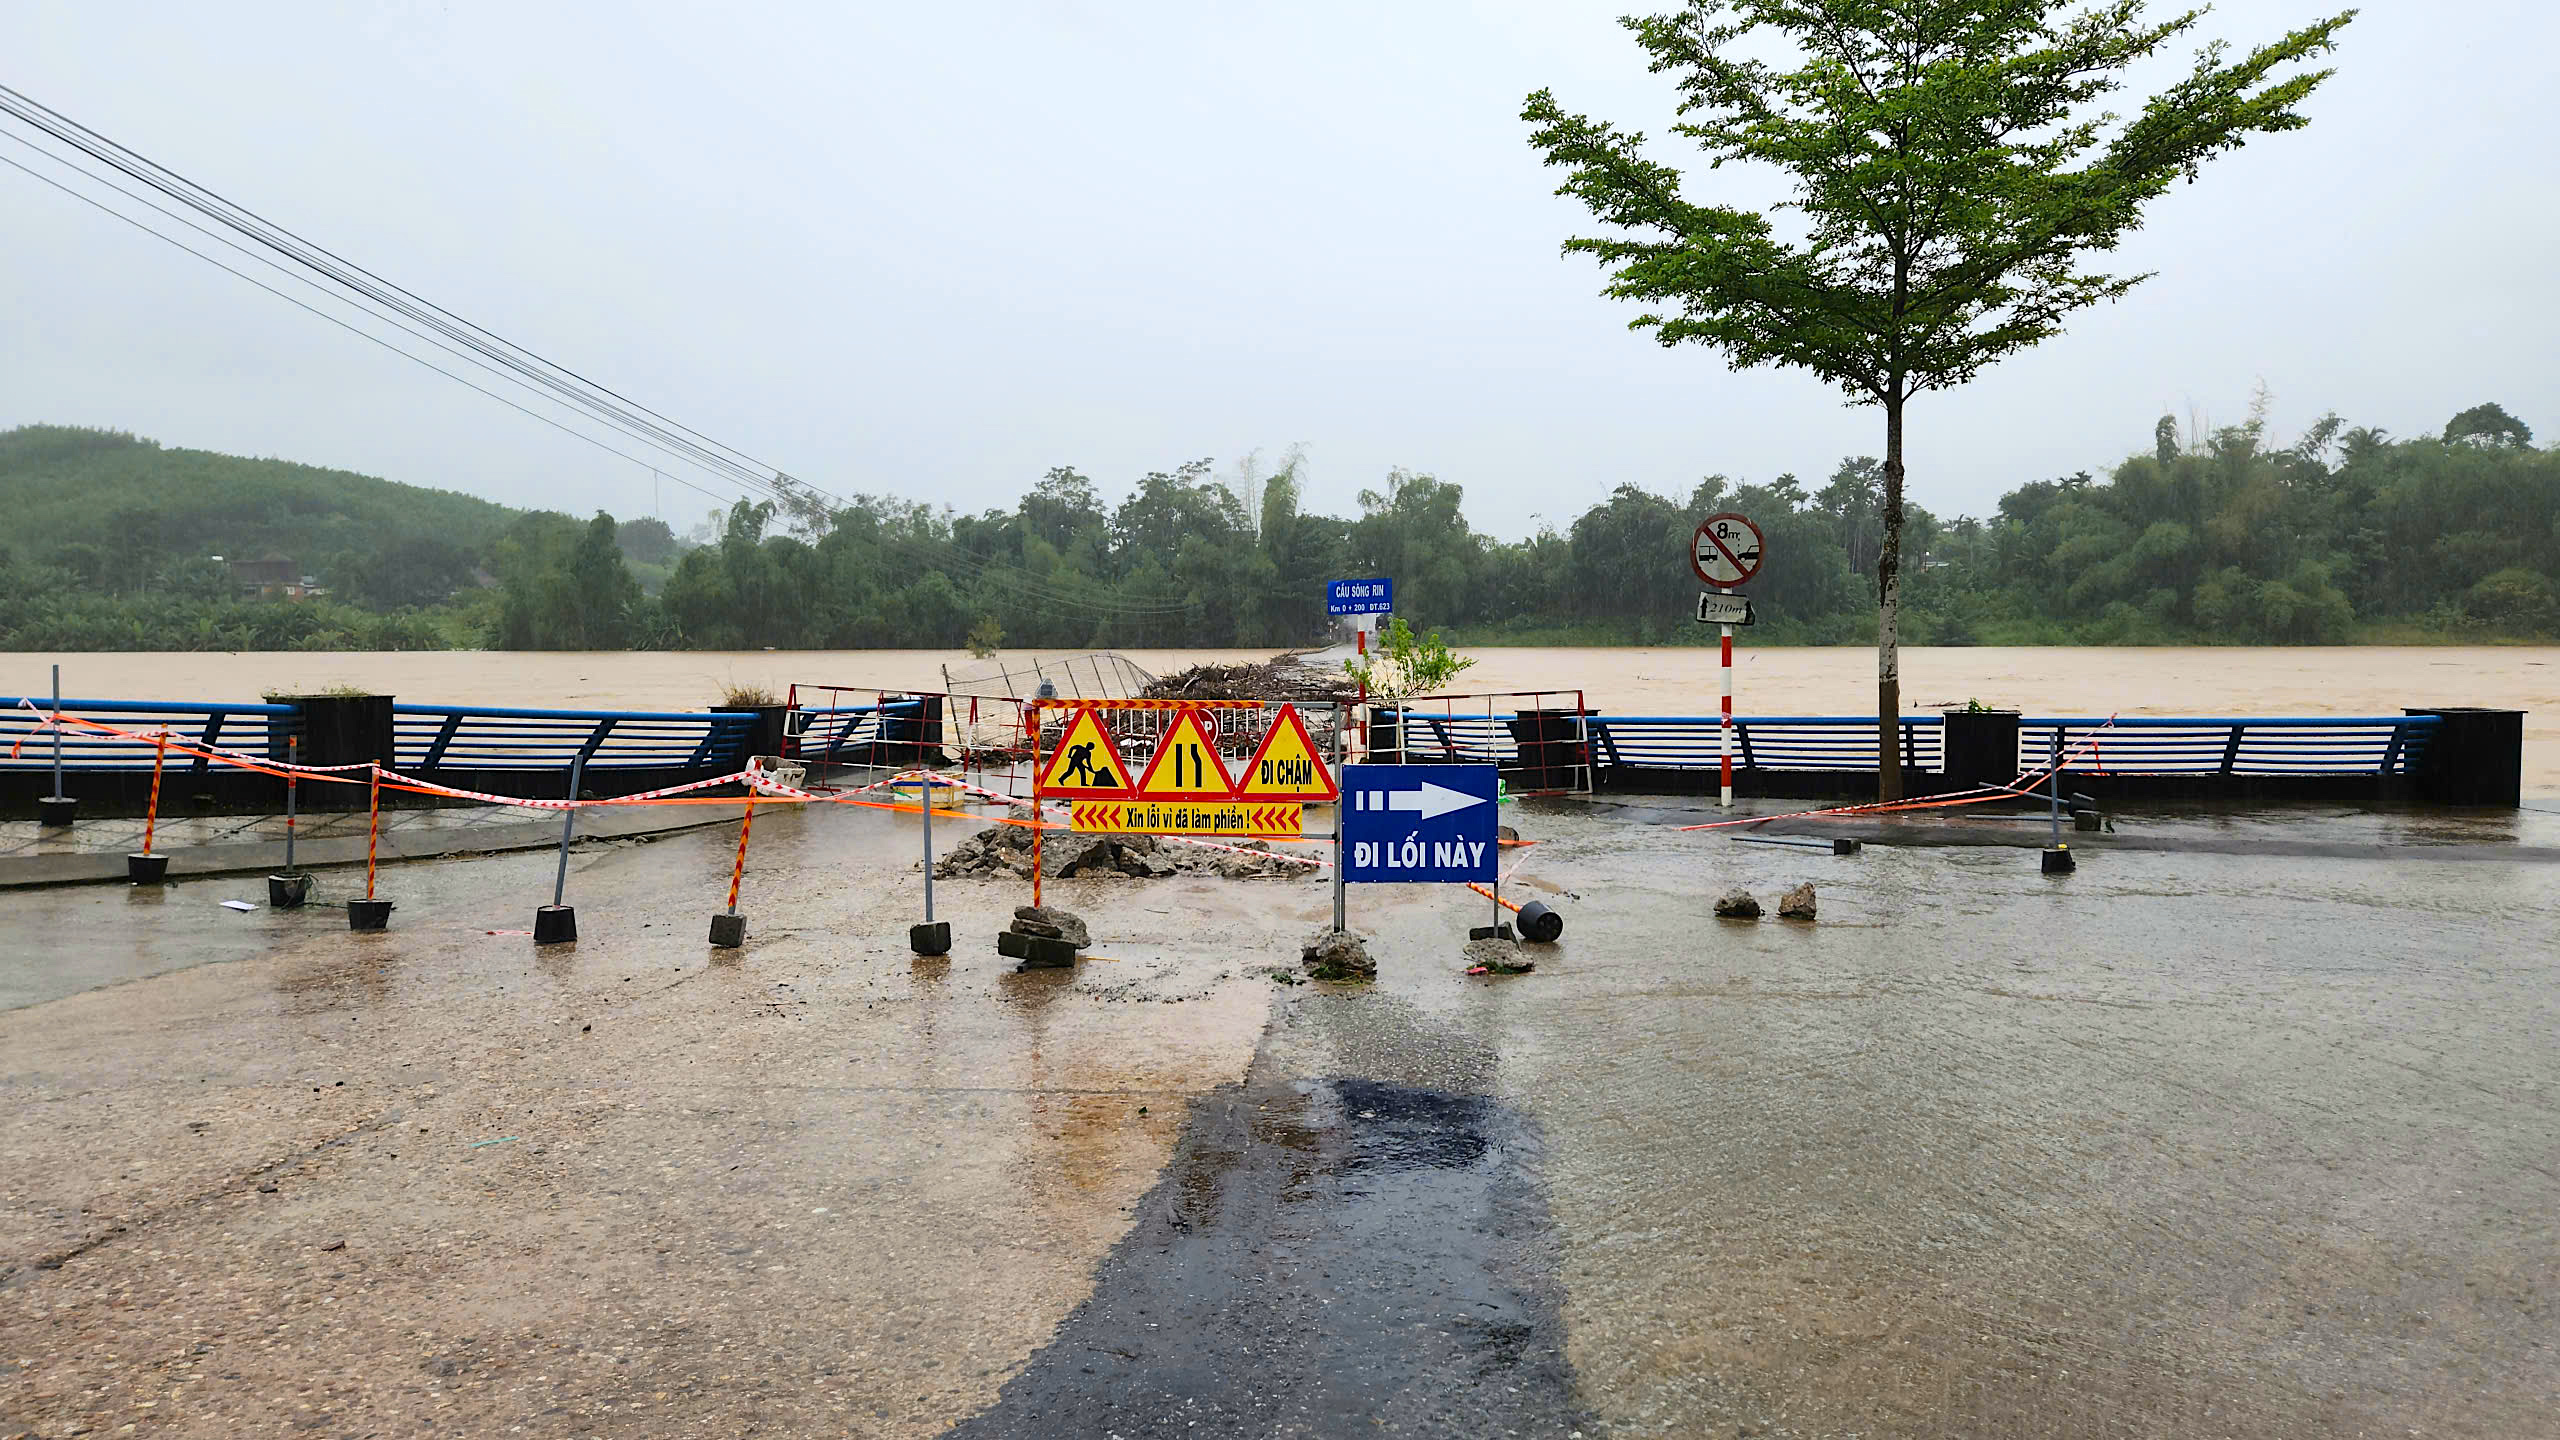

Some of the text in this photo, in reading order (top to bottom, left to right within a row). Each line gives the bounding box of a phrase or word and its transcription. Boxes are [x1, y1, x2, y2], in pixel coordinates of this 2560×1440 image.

[1716, 522, 1740, 540] 8m
[1372, 584, 1384, 596] RIN
[1709, 603, 1743, 614] 210m
[1261, 754, 1312, 793] ĐI CHẬM
[1126, 807, 1144, 828] Xin
[1147, 803, 1160, 828] lỗi
[1163, 808, 1173, 829] vì
[1175, 807, 1189, 829] đã
[1191, 807, 1211, 829] làm
[1214, 805, 1244, 832] phiền
[1354, 830, 1486, 868] ĐI LỐI NÀY
